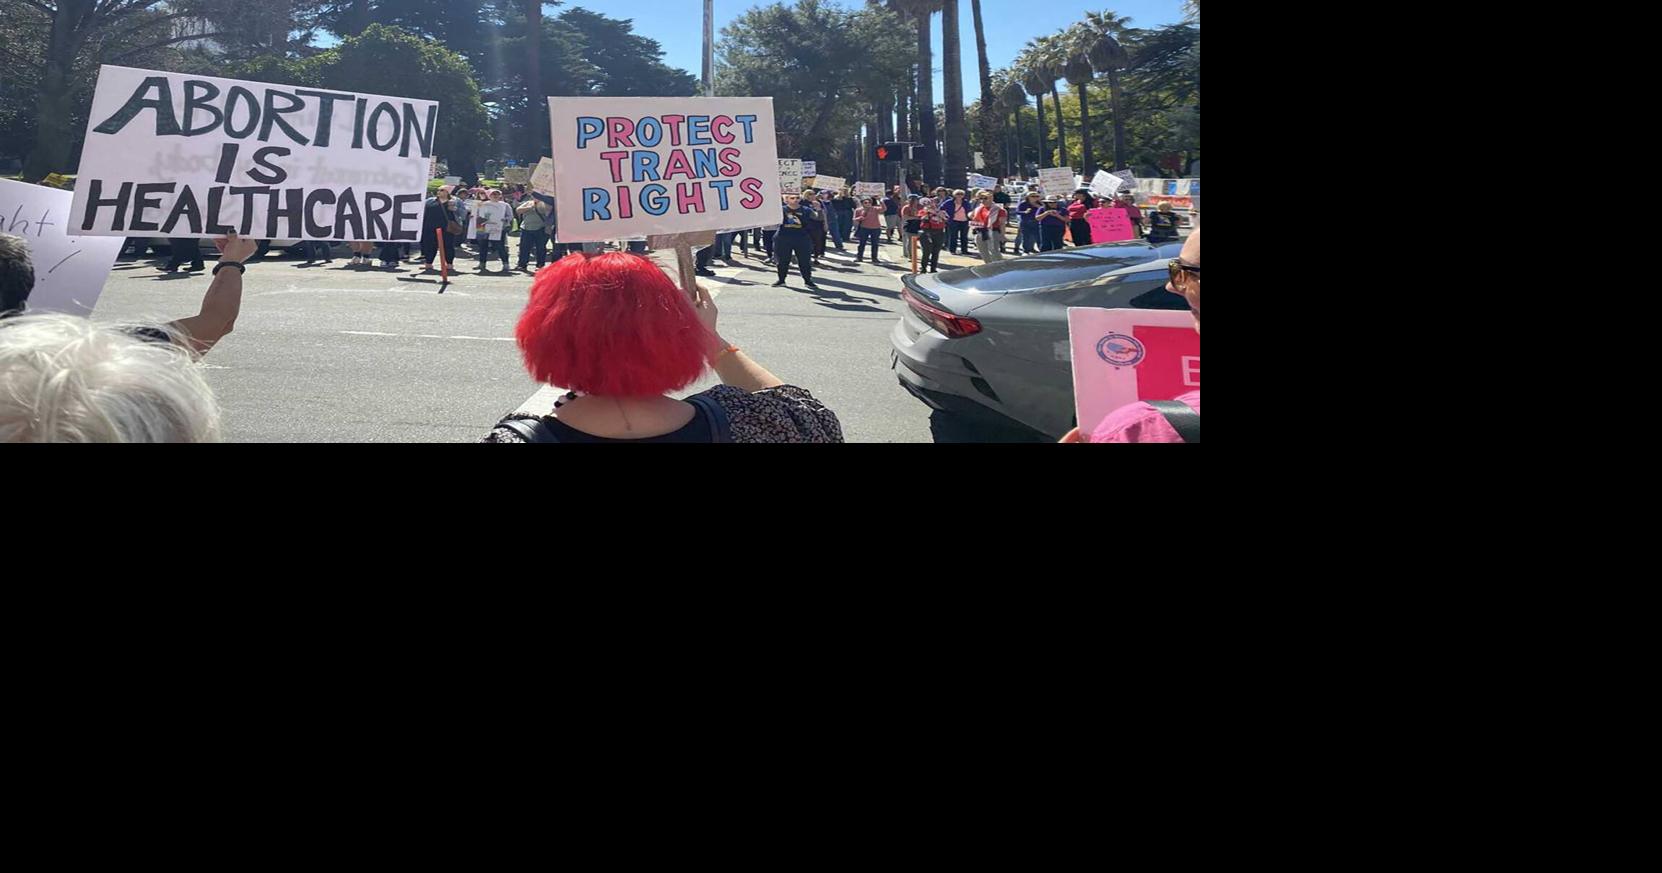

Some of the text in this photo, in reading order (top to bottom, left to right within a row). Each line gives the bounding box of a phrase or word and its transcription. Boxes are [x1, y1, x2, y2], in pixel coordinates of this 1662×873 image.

[93, 77, 438, 158] ABORTION
[576, 114, 757, 149] PROTECT
[215, 143, 291, 185] IS
[600, 147, 742, 183] TRANS
[81, 179, 422, 240] HEALTHCARE
[582, 177, 764, 221] RIGHTS
